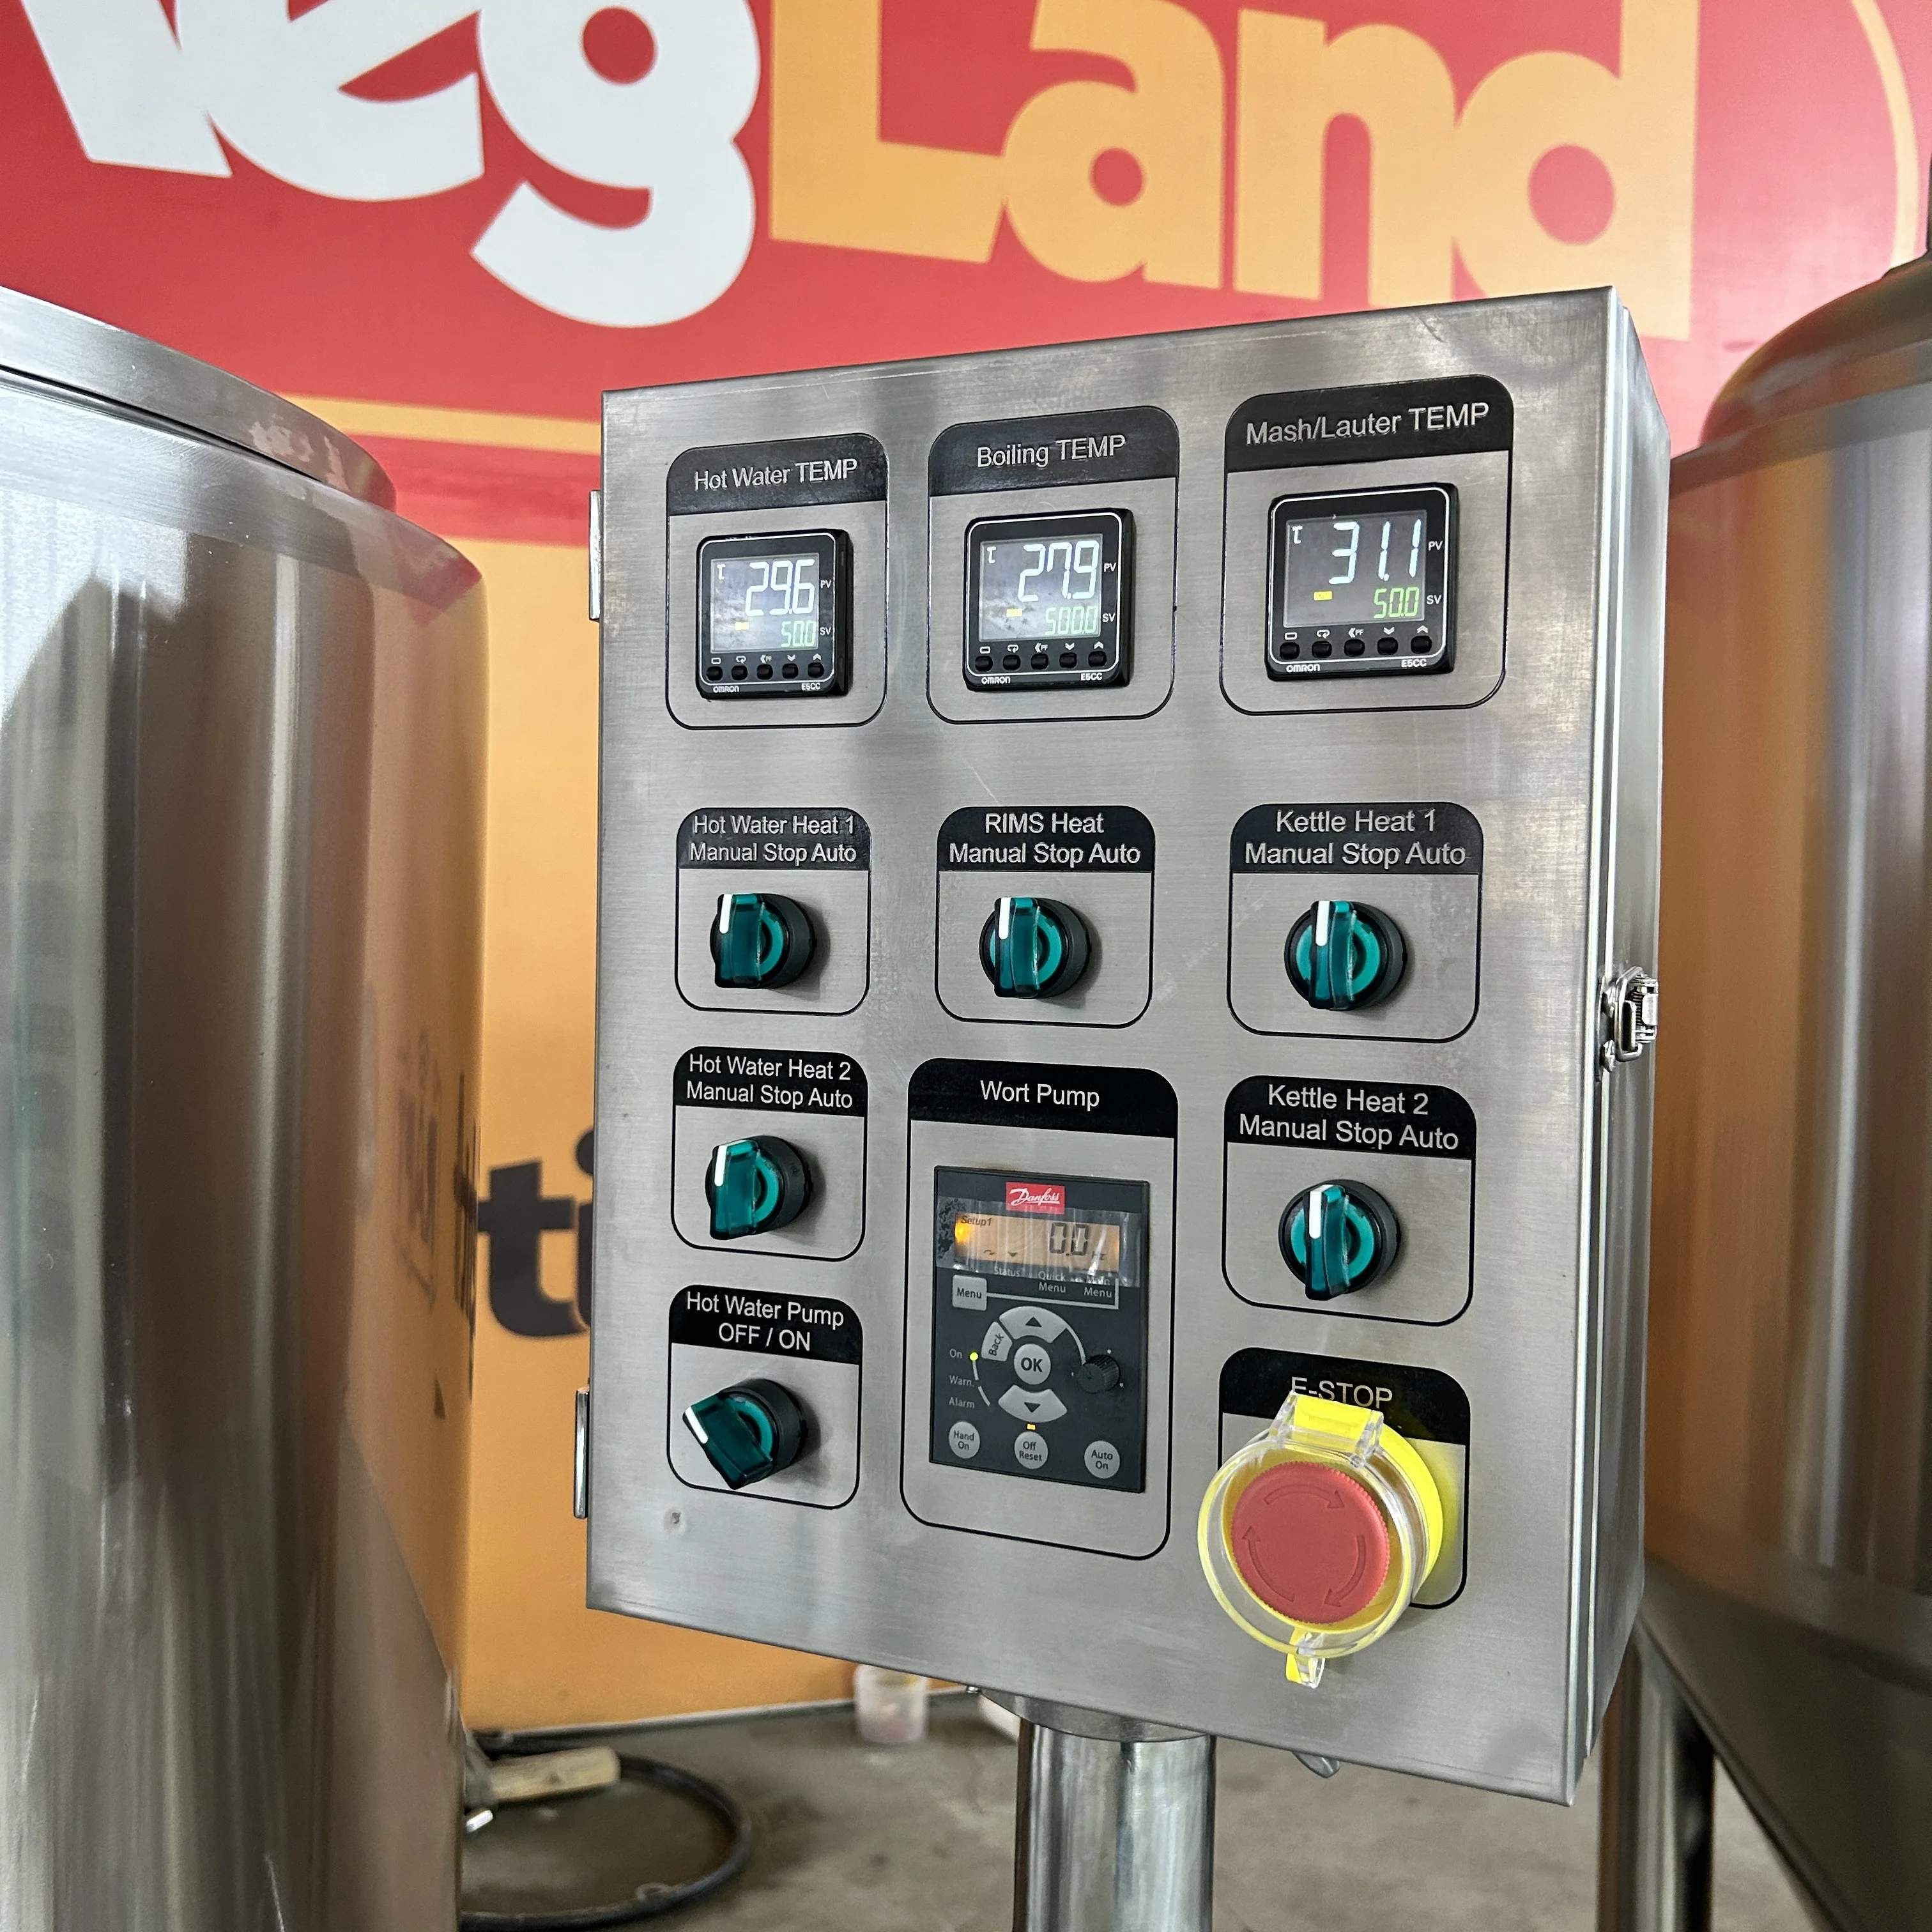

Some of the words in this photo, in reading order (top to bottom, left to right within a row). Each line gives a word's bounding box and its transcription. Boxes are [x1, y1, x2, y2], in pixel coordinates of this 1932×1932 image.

[1246, 413, 1402, 445] Mash/Lauter
[1408, 402, 1489, 431] TEMP
[977, 443, 1048, 468] Boiling
[1055, 434, 1125, 461] TEMP
[694, 470, 728, 491] Hot
[732, 466, 790, 488] Water
[794, 458, 857, 483] TEMP
[1328, 518, 1422, 585] 31.1
[1428, 540, 1443, 551] PV
[1018, 540, 1100, 602] 27.9
[1103, 563, 1117, 572] PV
[745, 559, 815, 617] 29.6
[820, 579, 831, 588] PV
[1374, 587, 1420, 618] 50.0
[1426, 594, 1442, 604] SV
[1045, 606, 1098, 636] 500.0
[1102, 613, 1116, 623] SV
[781, 620, 816, 647] 50.0
[820, 627, 831, 636] SV
[1286, 663, 1321, 673] OMRON
[1401, 659, 1427, 668] E5CC
[801, 682, 821, 691] E5CC
[981, 676, 1011, 685] OMRON
[1080, 673, 1103, 681] E5CC
[693, 815, 726, 834] Hot
[730, 815, 788, 834] Water
[792, 815, 839, 834] Heat
[845, 815, 854, 834] 1
[985, 812, 1044, 834] RIMS
[1051, 812, 1104, 834] Heat
[1276, 809, 1347, 832] Kettle
[1354, 809, 1416, 832] Heat
[1423, 809, 1436, 832] 1
[689, 842, 757, 862] Manual
[763, 842, 807, 866] Stop
[811, 843, 857, 862] Auto
[949, 842, 1027, 863] Manual
[1033, 841, 1084, 868] Stop
[1088, 842, 1141, 864] Auto
[1245, 841, 1334, 864] Manual
[1342, 842, 1400, 870] Stop
[1405, 841, 1466, 864] Auto
[689, 1054, 721, 1074] Hot
[726, 1055, 782, 1077] Water
[788, 1059, 834, 1080] Heat
[839, 1061, 851, 1080] 2
[686, 1080, 754, 1103] Manual
[760, 1084, 803, 1110] Stop
[808, 1087, 853, 1108] Auto
[980, 1080, 1030, 1103] Wort
[1037, 1084, 1100, 1112] Pump
[1268, 1084, 1337, 1109] Kettle
[1346, 1089, 1406, 1114] Heat
[1413, 1092, 1429, 1115] 2
[1239, 1113, 1326, 1140] Manual
[1336, 1120, 1393, 1150] Stop
[1399, 1124, 1459, 1150] Auto
[1009, 1187, 1061, 1206] Danfoss
[1038, 1270, 1066, 1282] Quick
[956, 1287, 982, 1299] Menu
[1038, 1282, 1066, 1294] Menu
[1084, 1287, 1112, 1298] Menu
[687, 1291, 719, 1313] Hot
[724, 1294, 781, 1319] Water
[788, 1301, 844, 1330] Pump
[719, 1322, 760, 1345] OFF
[766, 1327, 774, 1347] /
[779, 1329, 811, 1351] ON
[988, 1333, 1004, 1356] Back
[949, 1348, 963, 1359] On
[1020, 1357, 1043, 1373] OK
[1291, 1376, 1393, 1409] E-STOP
[949, 1397, 975, 1409] Alarm
[953, 1430, 974, 1441] Hand
[958, 1441, 970, 1450] On
[1022, 1441, 1036, 1450] Off
[1091, 1450, 1114, 1460] Auto
[1019, 1450, 1043, 1462] Reset
[1095, 1460, 1108, 1470] On
